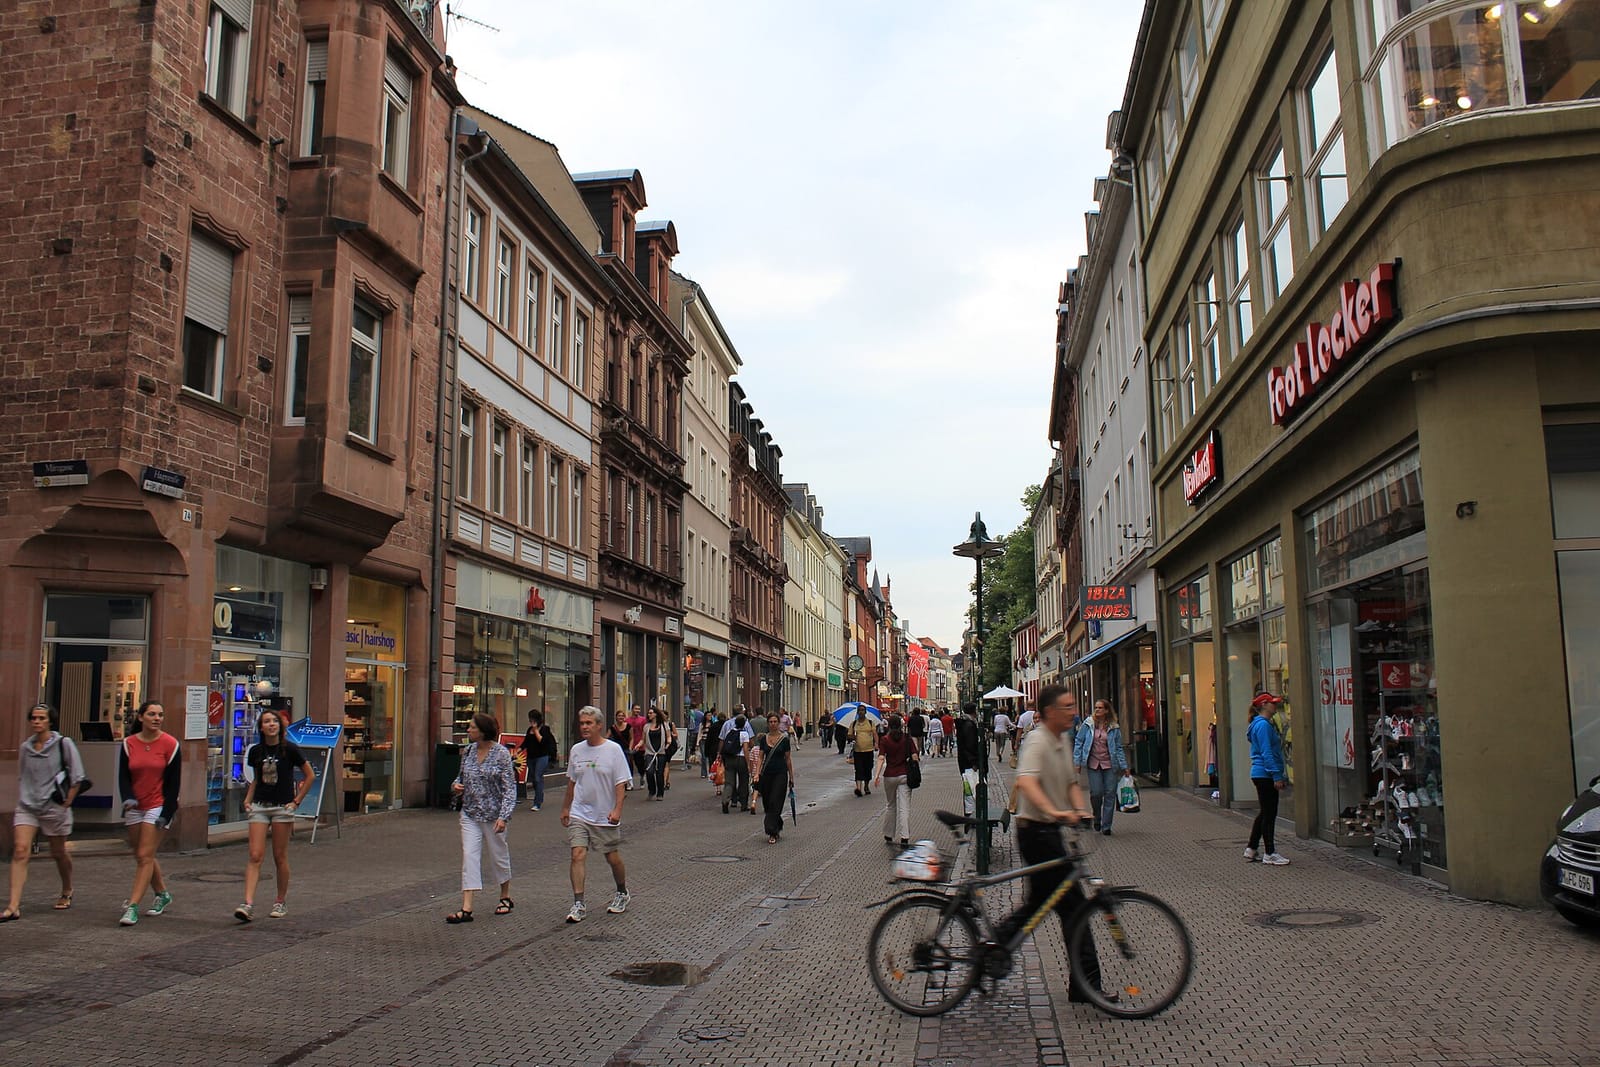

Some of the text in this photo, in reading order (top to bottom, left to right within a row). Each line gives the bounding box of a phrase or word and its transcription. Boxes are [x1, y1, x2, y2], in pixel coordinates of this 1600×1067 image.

[1306, 262, 1392, 385] Locker
[1087, 585, 1126, 601] IBIZA
[1083, 603, 1131, 620] SHOES
[364, 629, 395, 653] hairshop
[1320, 678, 1353, 706] SALE
